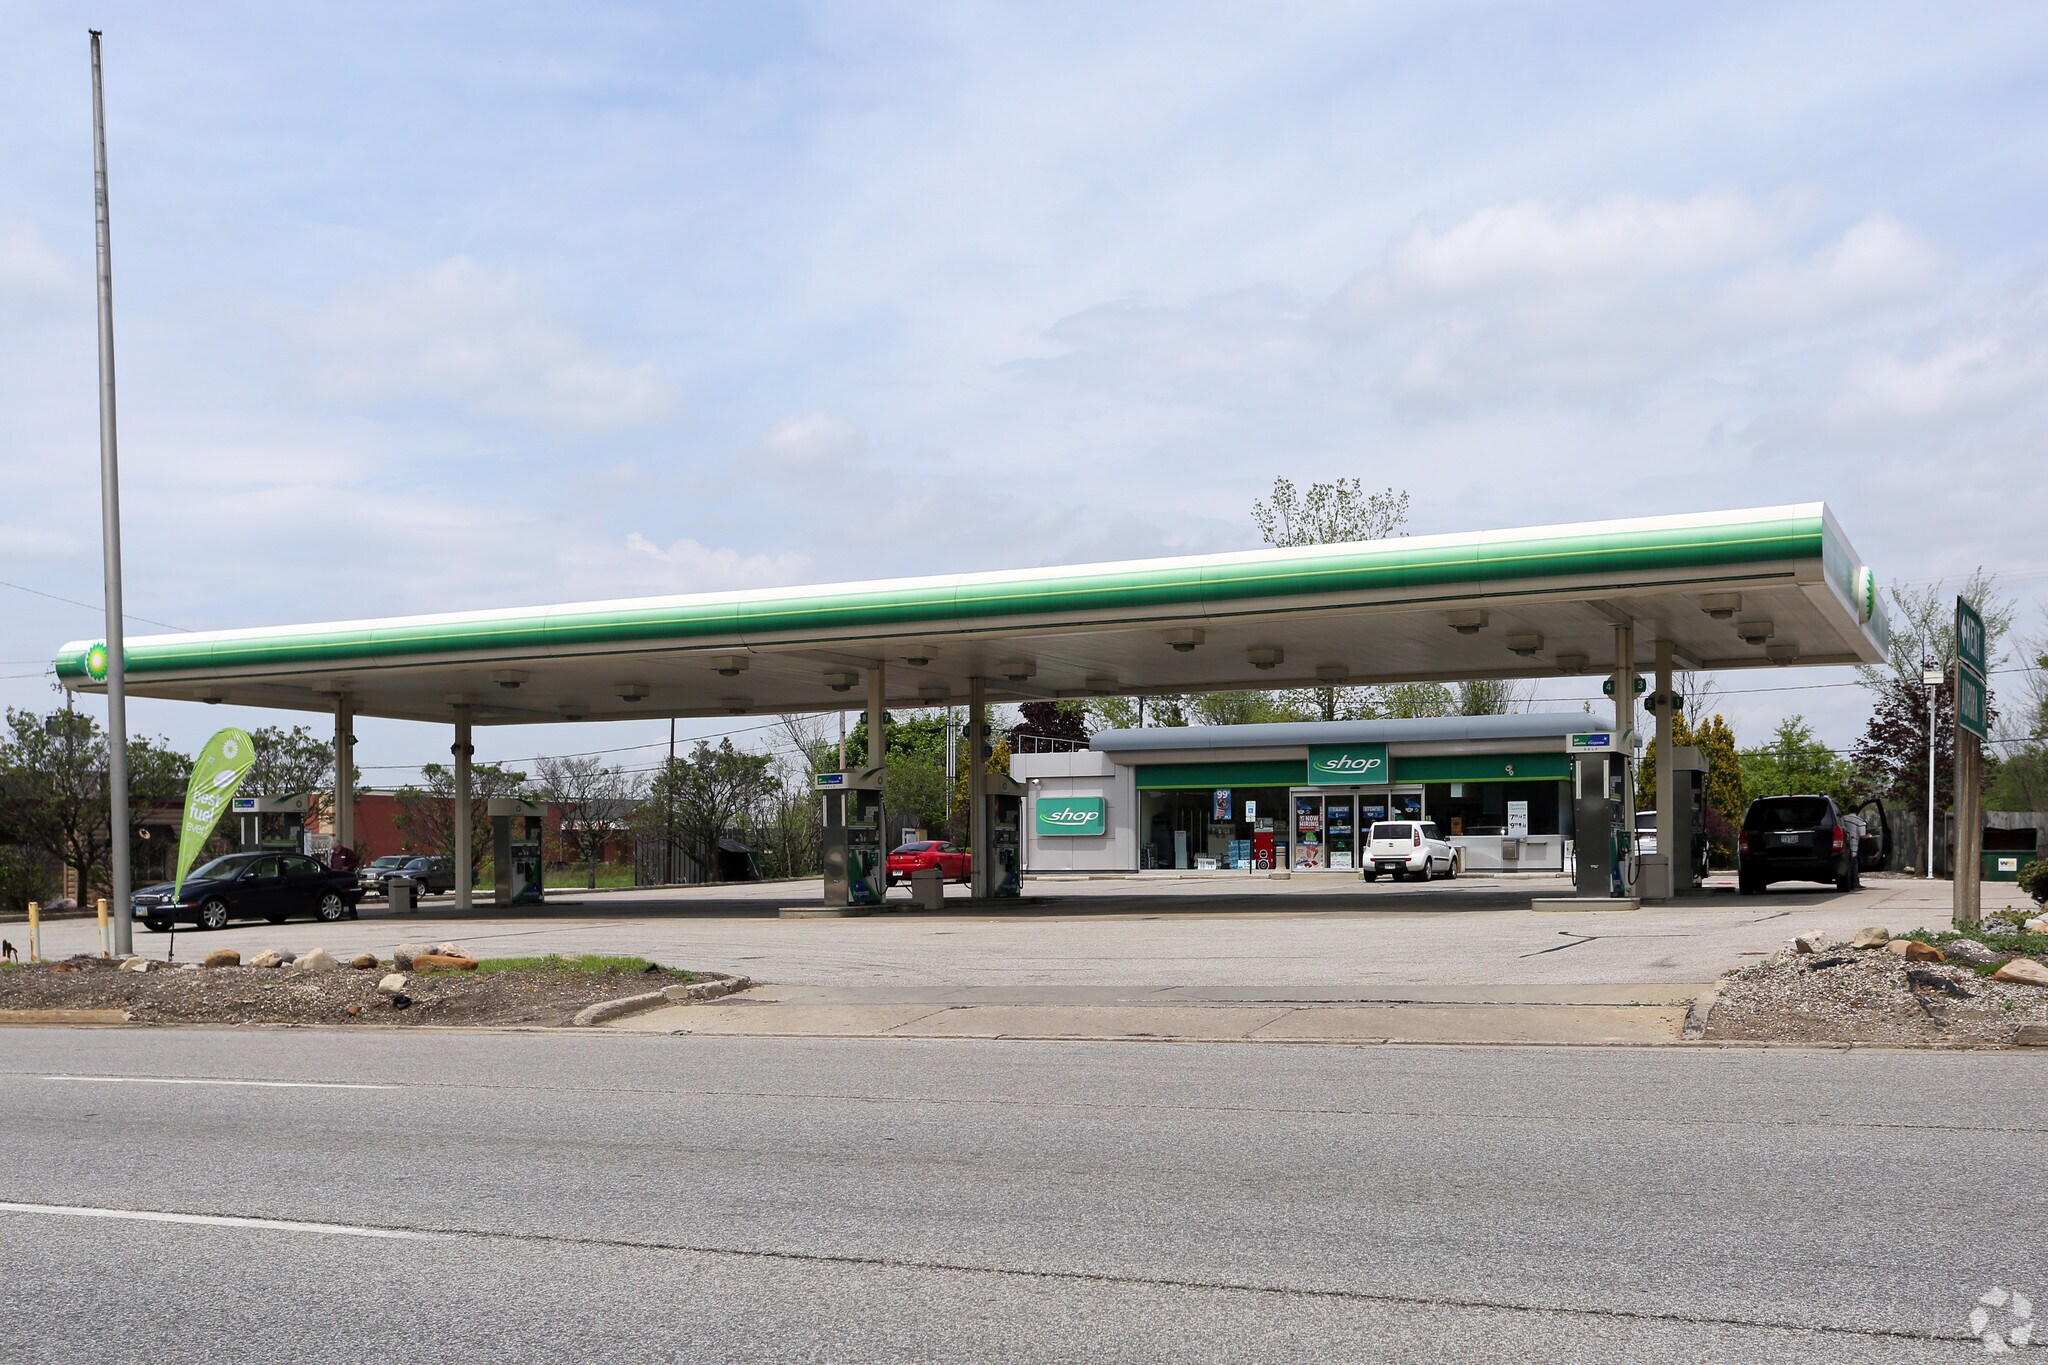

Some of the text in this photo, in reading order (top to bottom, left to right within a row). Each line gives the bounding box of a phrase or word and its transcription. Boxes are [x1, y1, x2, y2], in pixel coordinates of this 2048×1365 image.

[1605, 683, 1611, 691] 4
[1637, 681, 1643, 689] 3
[1646, 699, 1652, 707] 2
[862, 713, 867, 722] 8
[884, 713, 889, 721] 7
[1320, 754, 1381, 774] shop
[193, 786, 221, 807] best
[189, 802, 215, 824] fuel
[1046, 807, 1099, 826] shop
